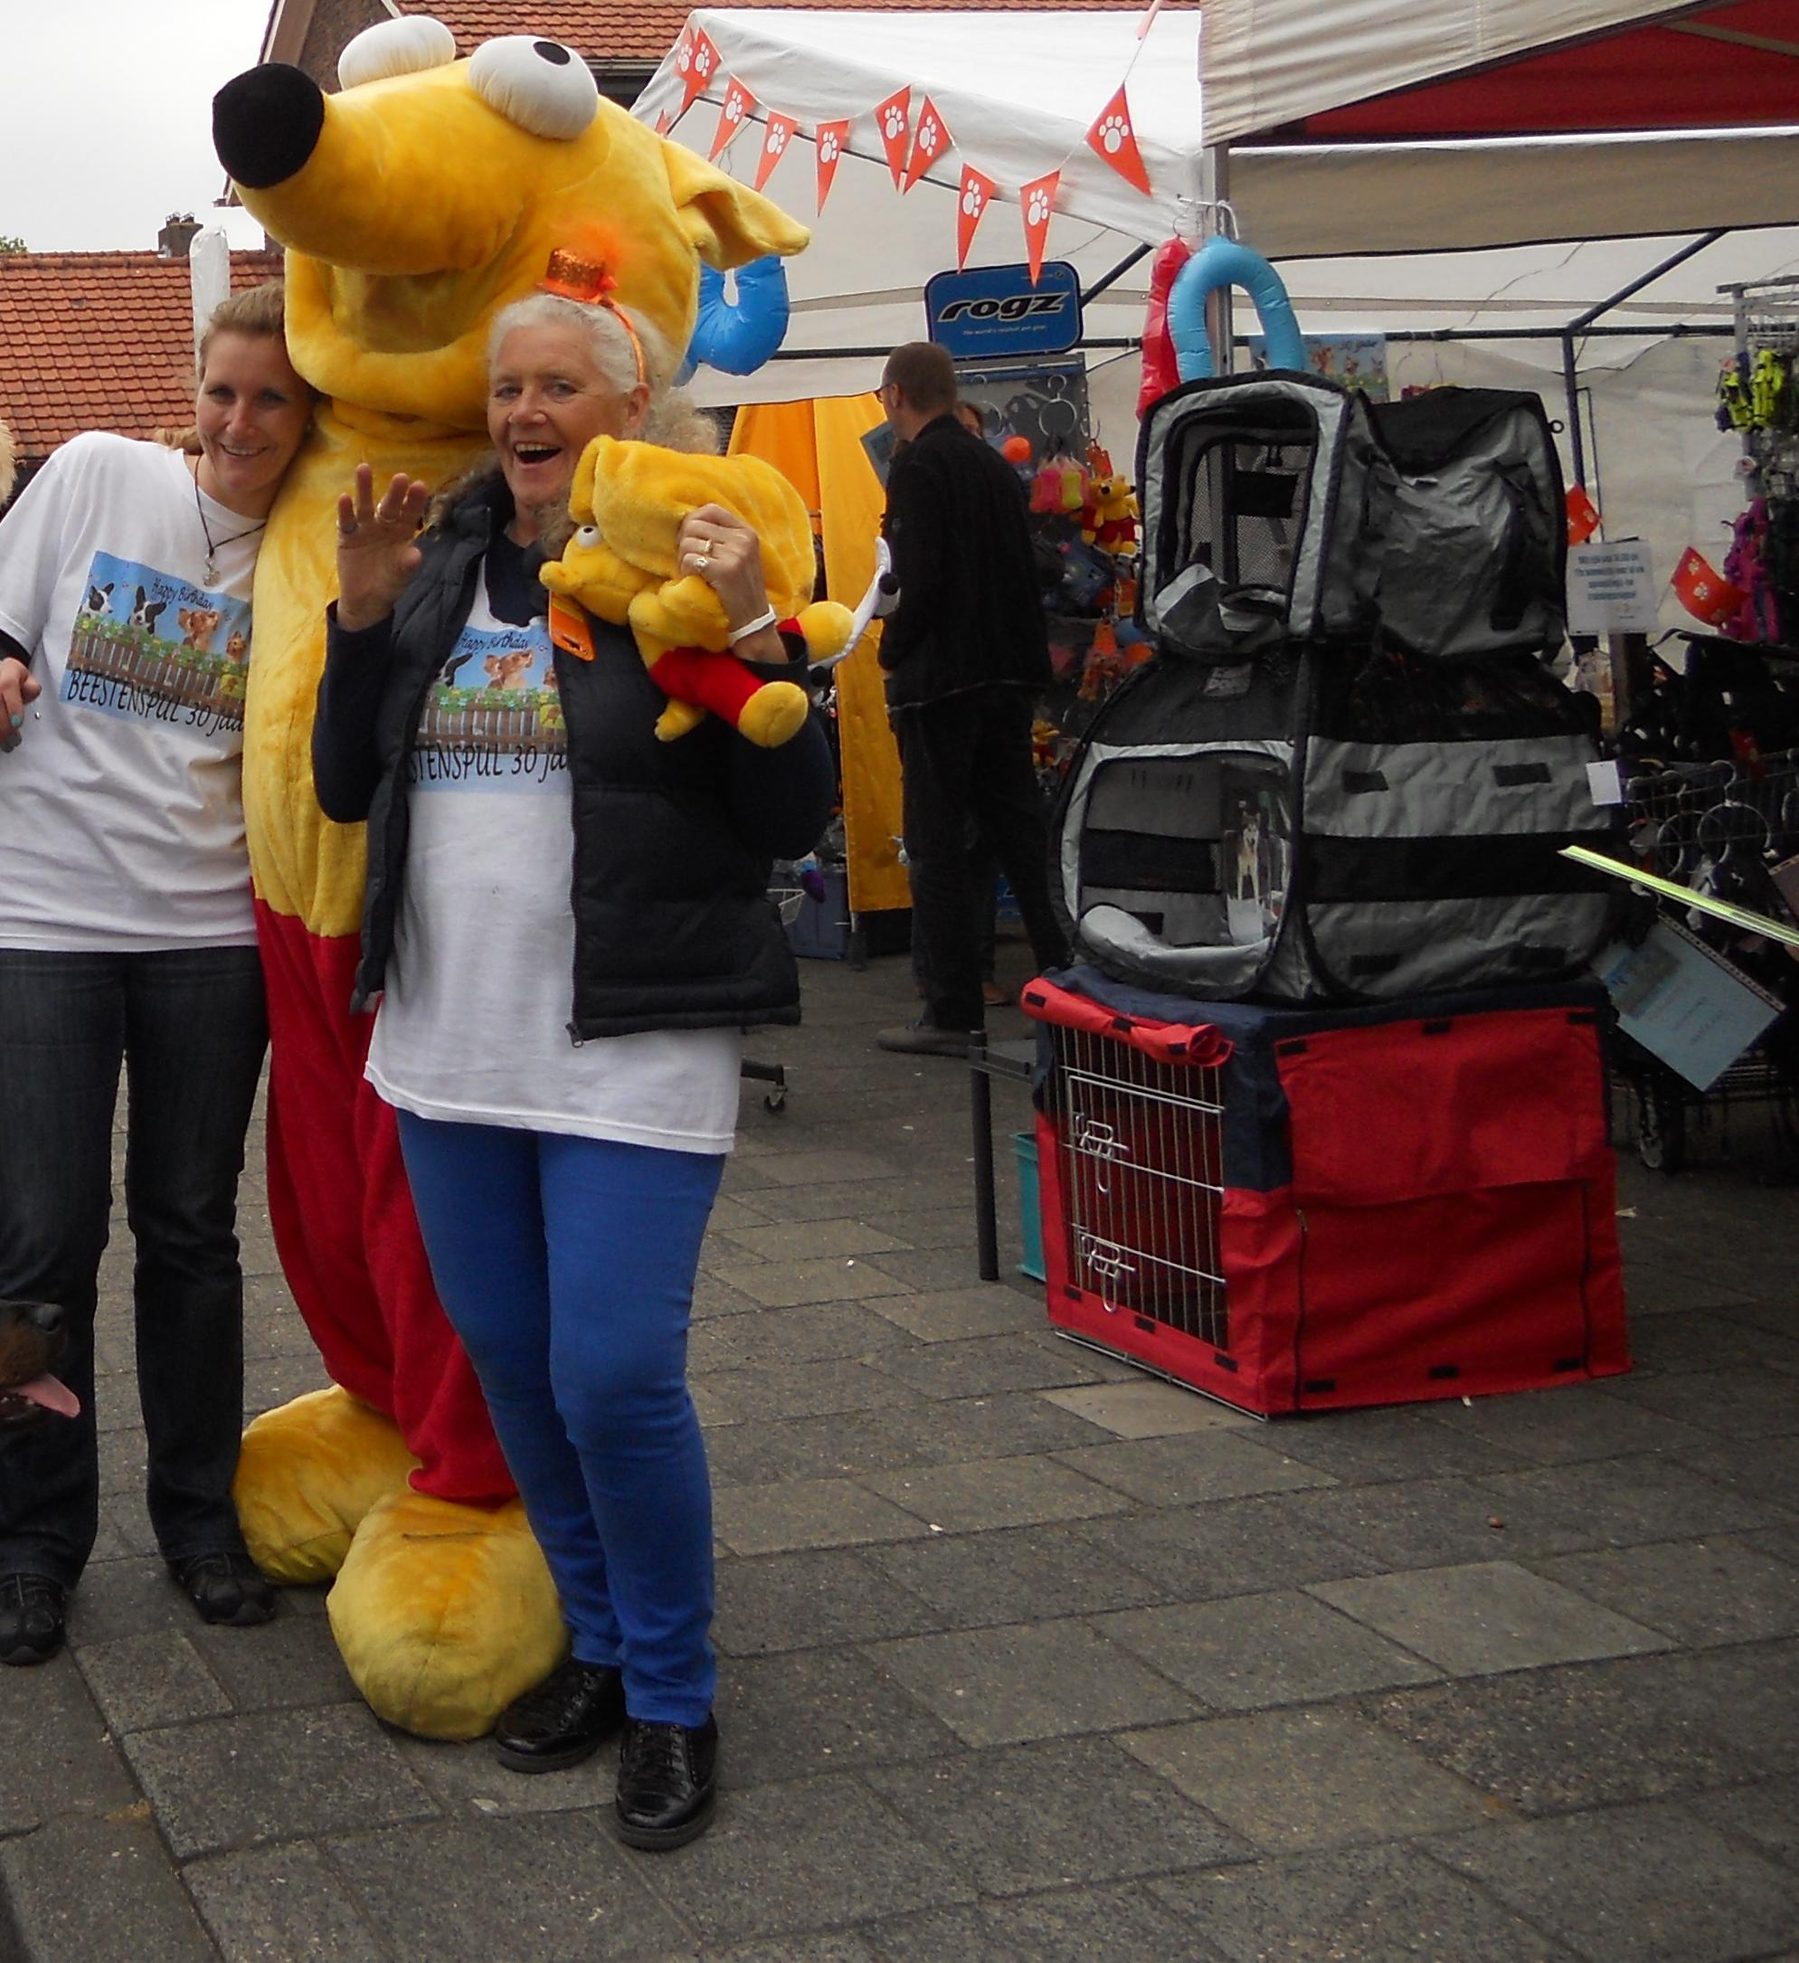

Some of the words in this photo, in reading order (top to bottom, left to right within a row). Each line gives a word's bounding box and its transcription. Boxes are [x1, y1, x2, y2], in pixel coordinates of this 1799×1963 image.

[936, 291, 1070, 323] rogz
[151, 577, 177, 604] Happy
[178, 586, 214, 610] Birthday
[457, 631, 484, 655] Happy
[486, 630, 529, 650] Birthday
[67, 667, 181, 723] BEESTENSPUL
[185, 702, 211, 727] 30
[206, 714, 244, 737] jaa
[408, 742, 503, 784] STENSPUL
[511, 744, 537, 774] 30
[538, 750, 568, 783] ja
